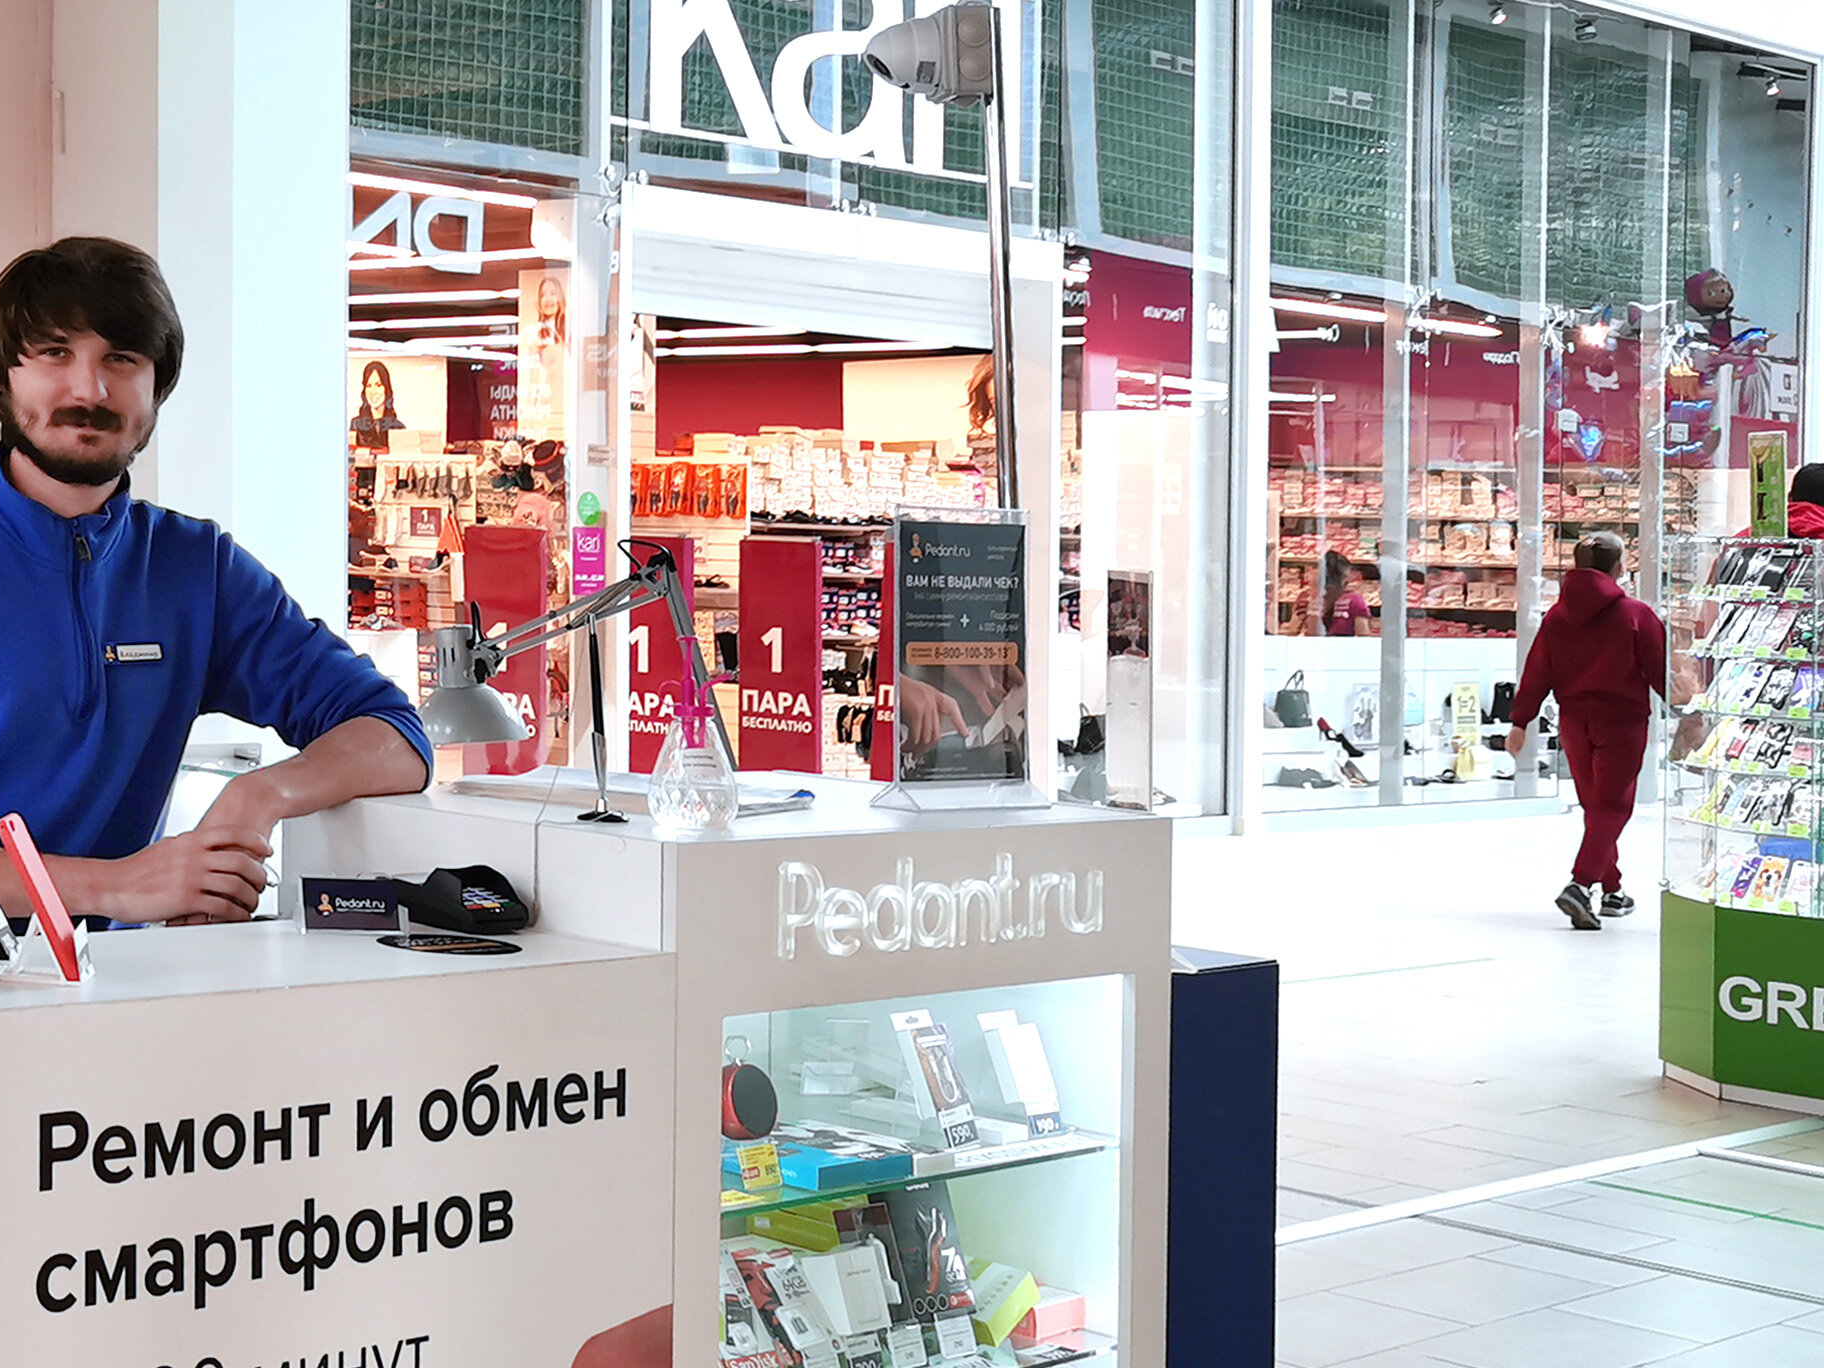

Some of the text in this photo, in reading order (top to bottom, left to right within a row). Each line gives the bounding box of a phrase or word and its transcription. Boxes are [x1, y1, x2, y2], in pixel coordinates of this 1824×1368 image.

[577, 532, 600, 552] kari
[925, 543, 971, 557] Pedant.ru
[906, 575, 1019, 590] ВАМ НЕ ВЫДАЛИ ЧЕК?
[629, 625, 649, 674] 1
[760, 627, 783, 673] 1
[629, 691, 677, 718] АРА
[742, 689, 812, 717] ПАРА
[742, 716, 812, 733] БЕСПЛАТНО
[335, 896, 385, 910] Pedant.ru
[777, 852, 1104, 960] Pedant.ru
[38, 1065, 627, 1192] Ремонт и обмен
[35, 1188, 514, 1314] смартфонов
